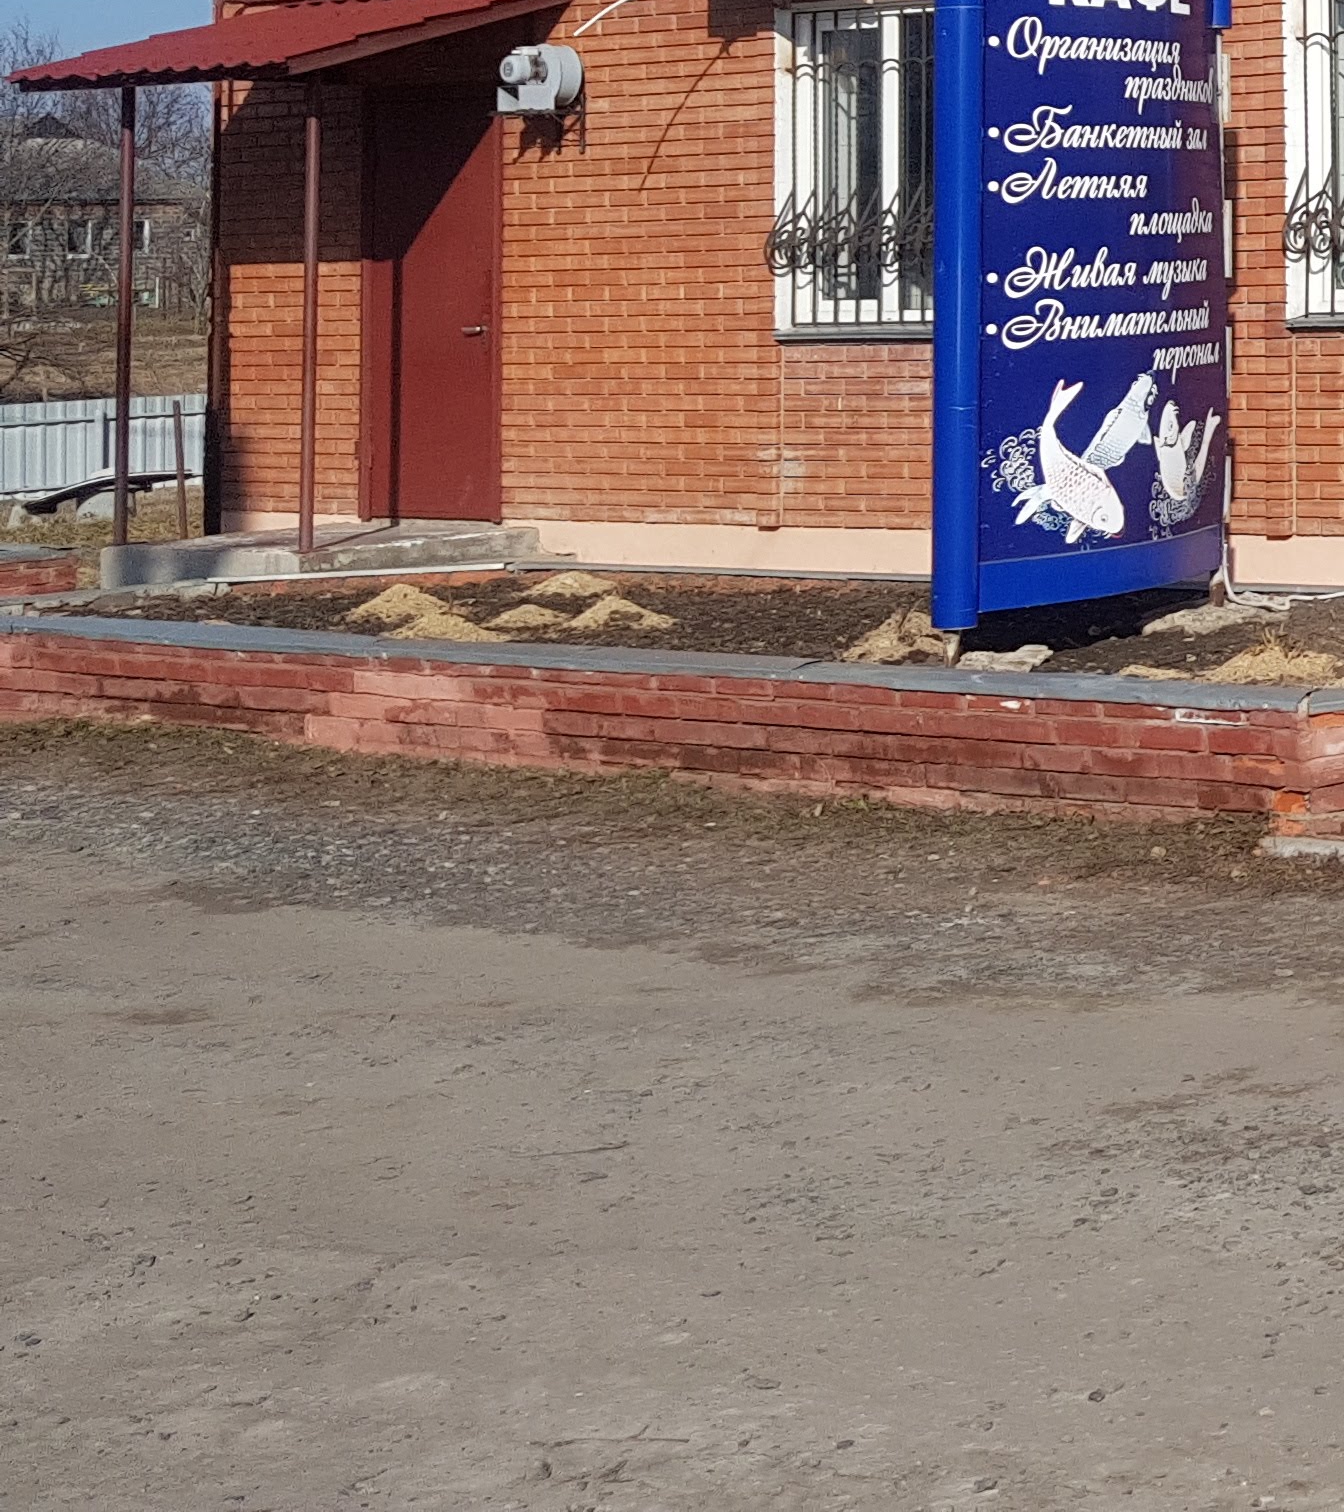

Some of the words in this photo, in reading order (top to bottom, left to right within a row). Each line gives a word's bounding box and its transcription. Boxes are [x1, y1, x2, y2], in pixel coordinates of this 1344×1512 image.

[1006, 16, 1181, 76] Организация
[1123, 64, 1214, 115] праздников
[1003, 104, 1182, 153] Банкетный
[1186, 127, 1207, 150] зал
[1001, 157, 1148, 204] Летняя
[1129, 197, 1213, 243] площадка
[1004, 246, 1137, 299] Живая
[1142, 258, 1208, 300] музыка
[1002, 299, 1209, 350] Внимательный
[1153, 341, 1220, 385] персонал
